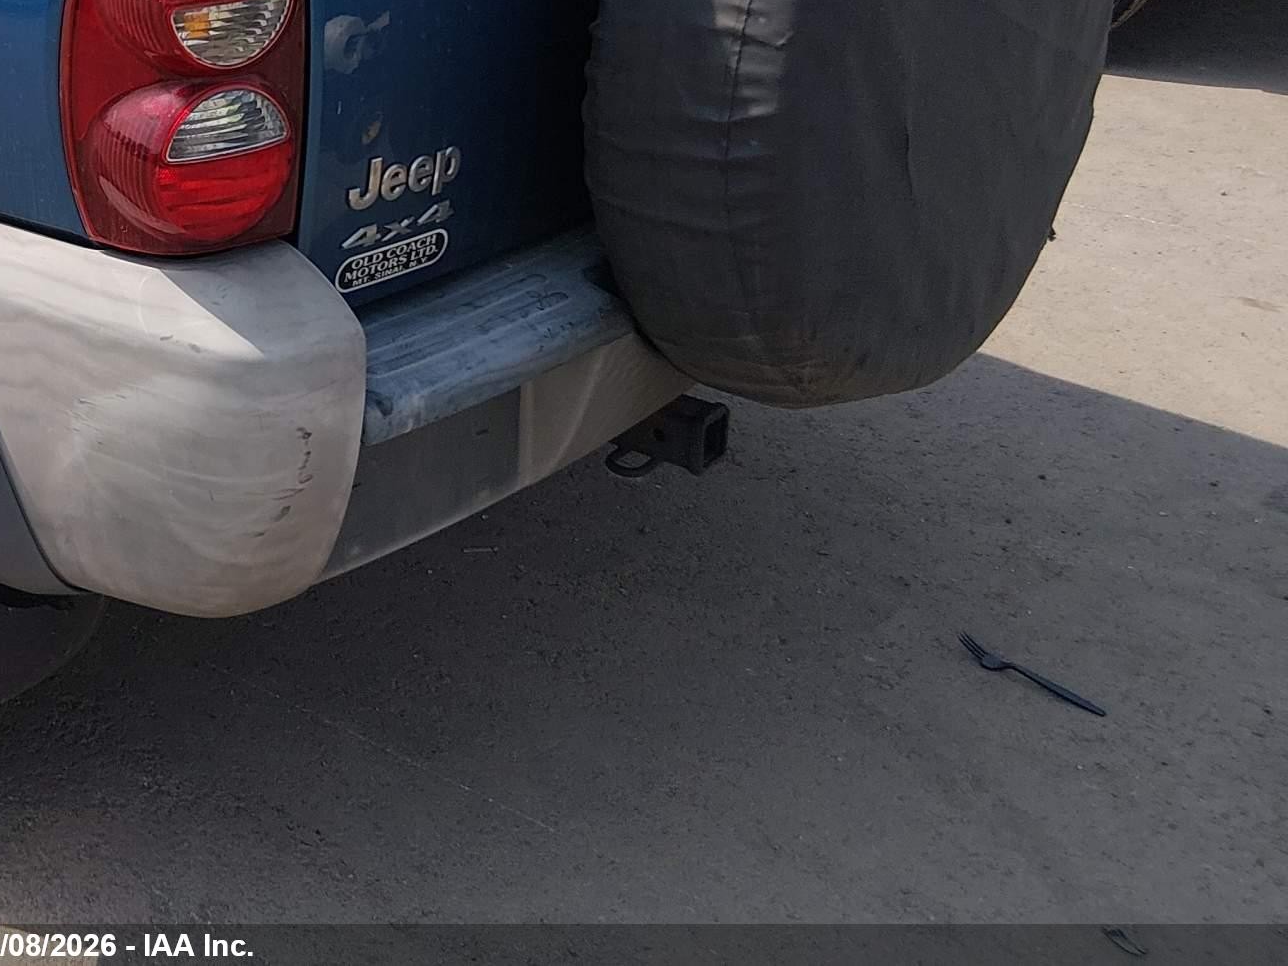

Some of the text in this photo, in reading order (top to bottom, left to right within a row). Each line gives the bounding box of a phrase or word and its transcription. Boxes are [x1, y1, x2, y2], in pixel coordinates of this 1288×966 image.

[348, 145, 462, 211] Jeep
[341, 199, 455, 250] 4x4
[343, 243, 440, 284] MOTORS LTD.
[351, 234, 437, 270] OLD COACH
